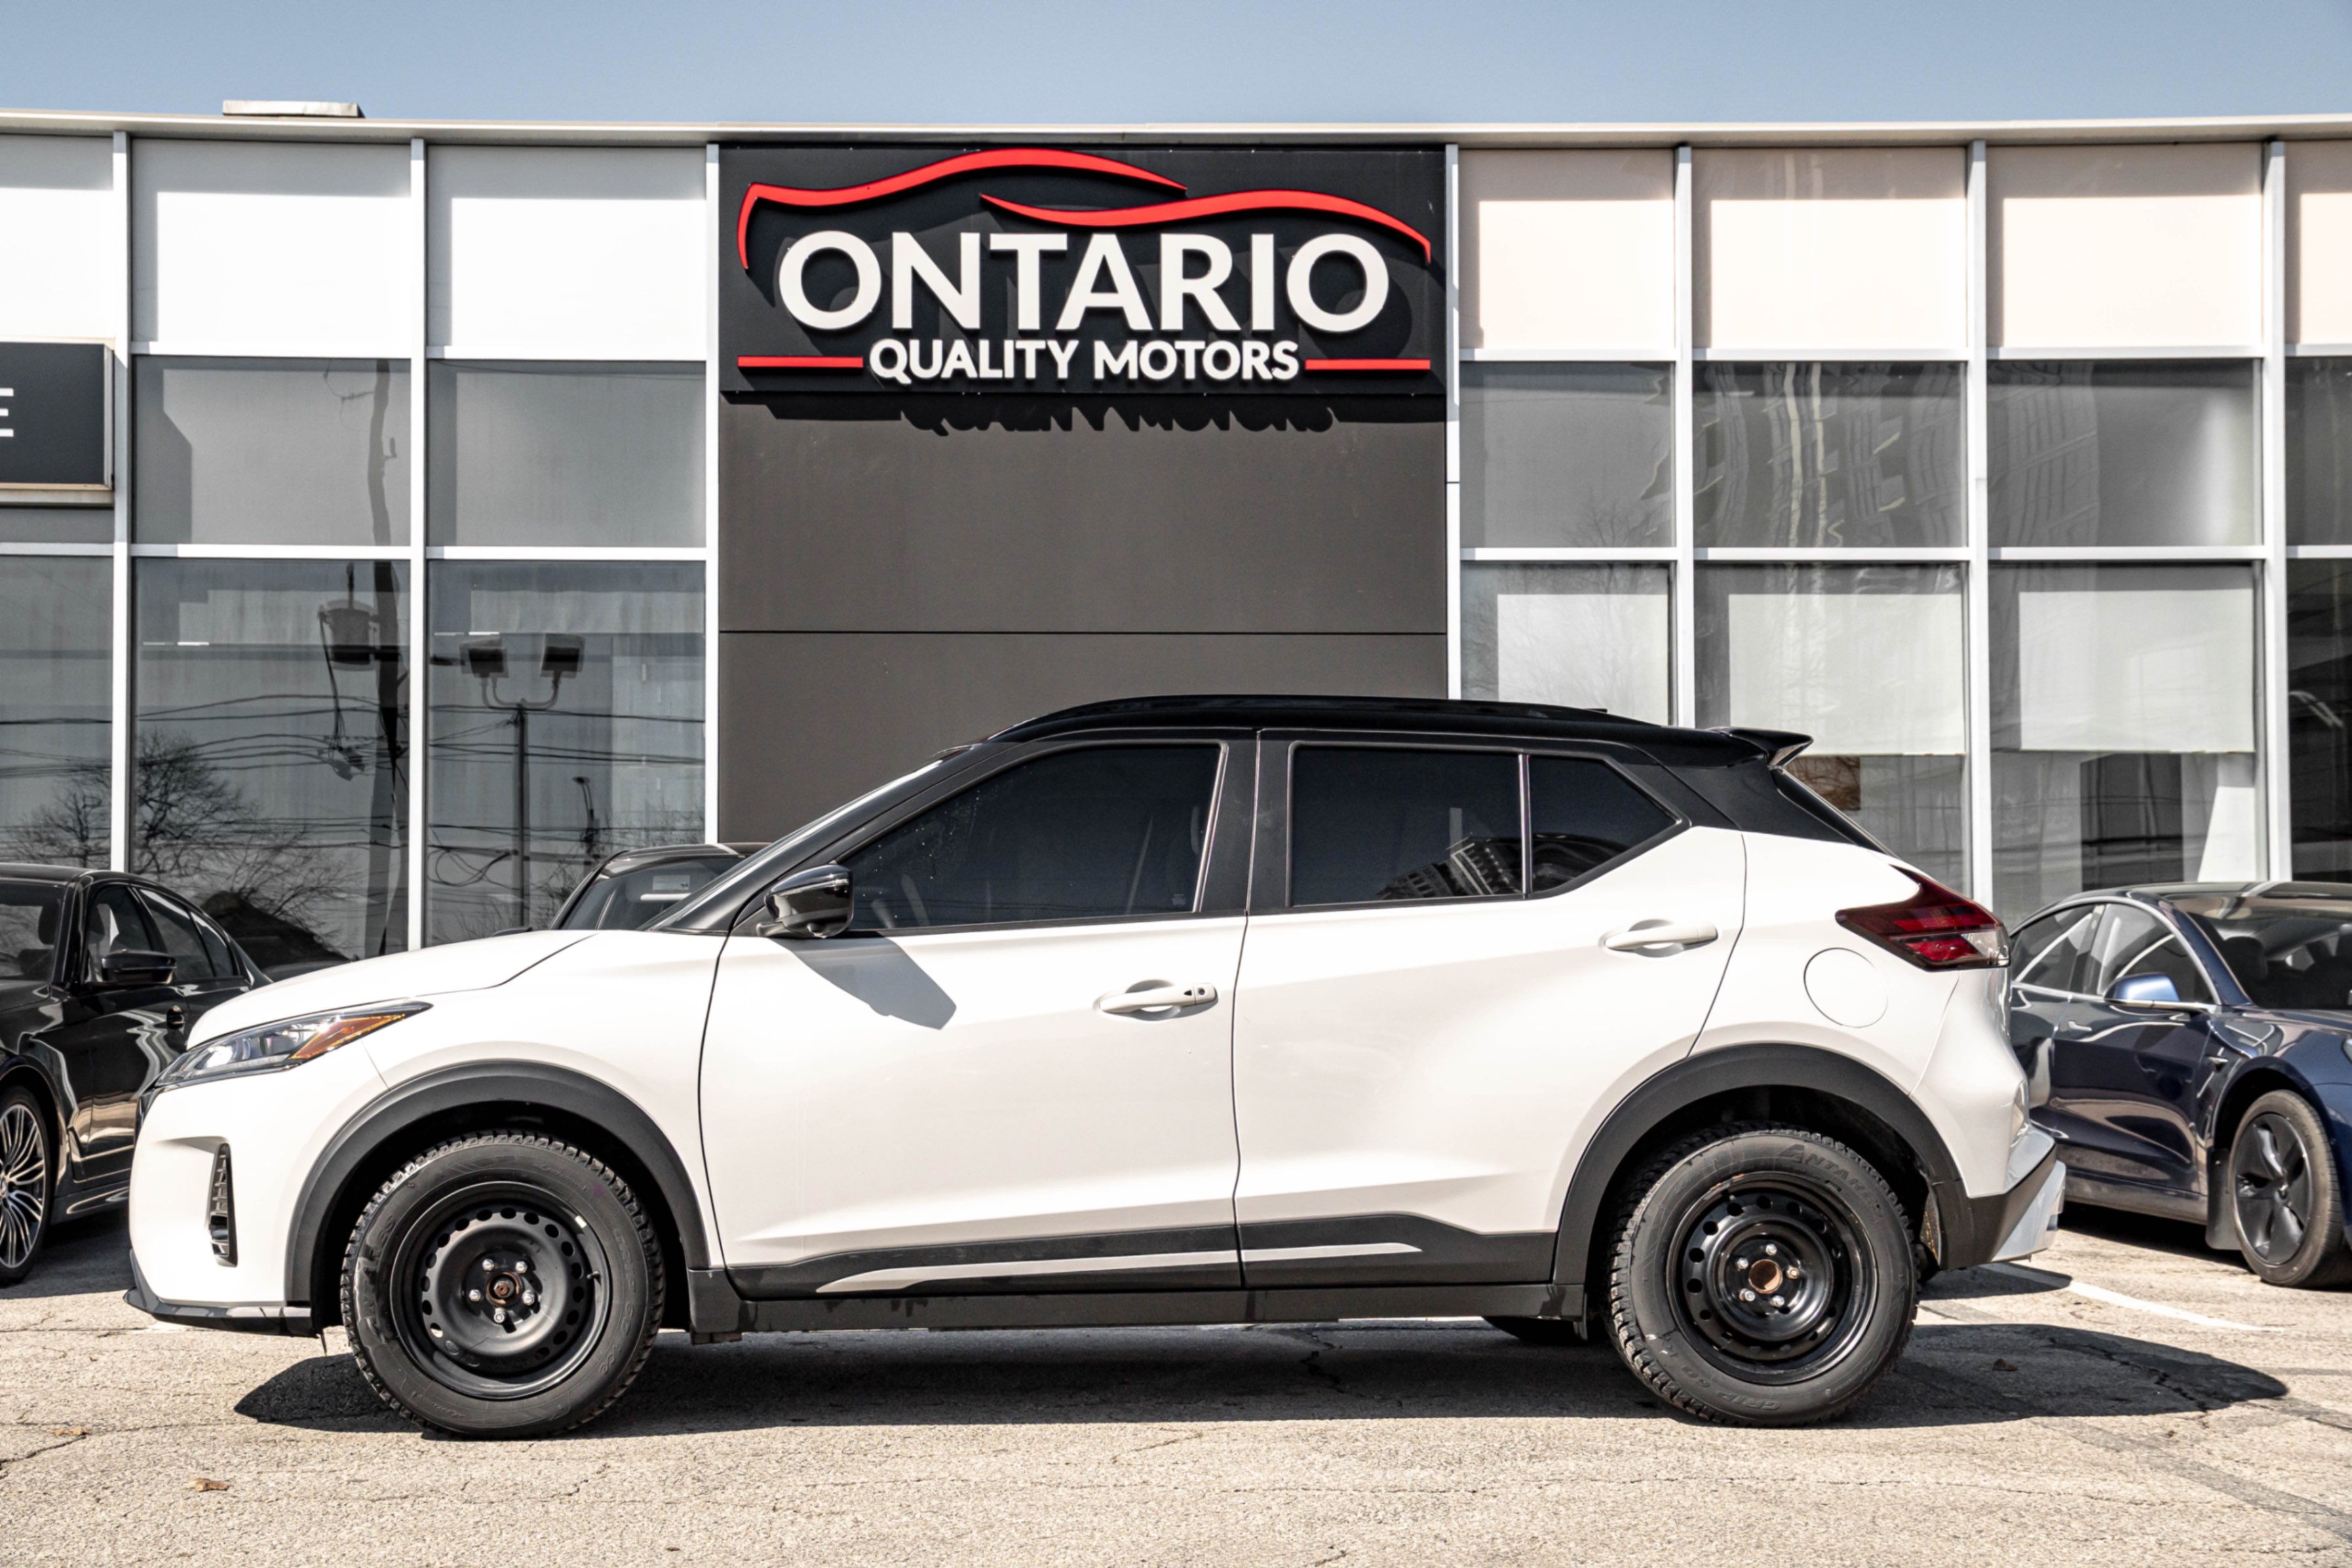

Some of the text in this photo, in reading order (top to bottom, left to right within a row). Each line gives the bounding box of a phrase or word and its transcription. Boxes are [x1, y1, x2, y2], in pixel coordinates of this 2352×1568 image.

[779, 231, 1388, 332] ONTARIO
[870, 339, 1298, 383] QUALITY MOTORS
